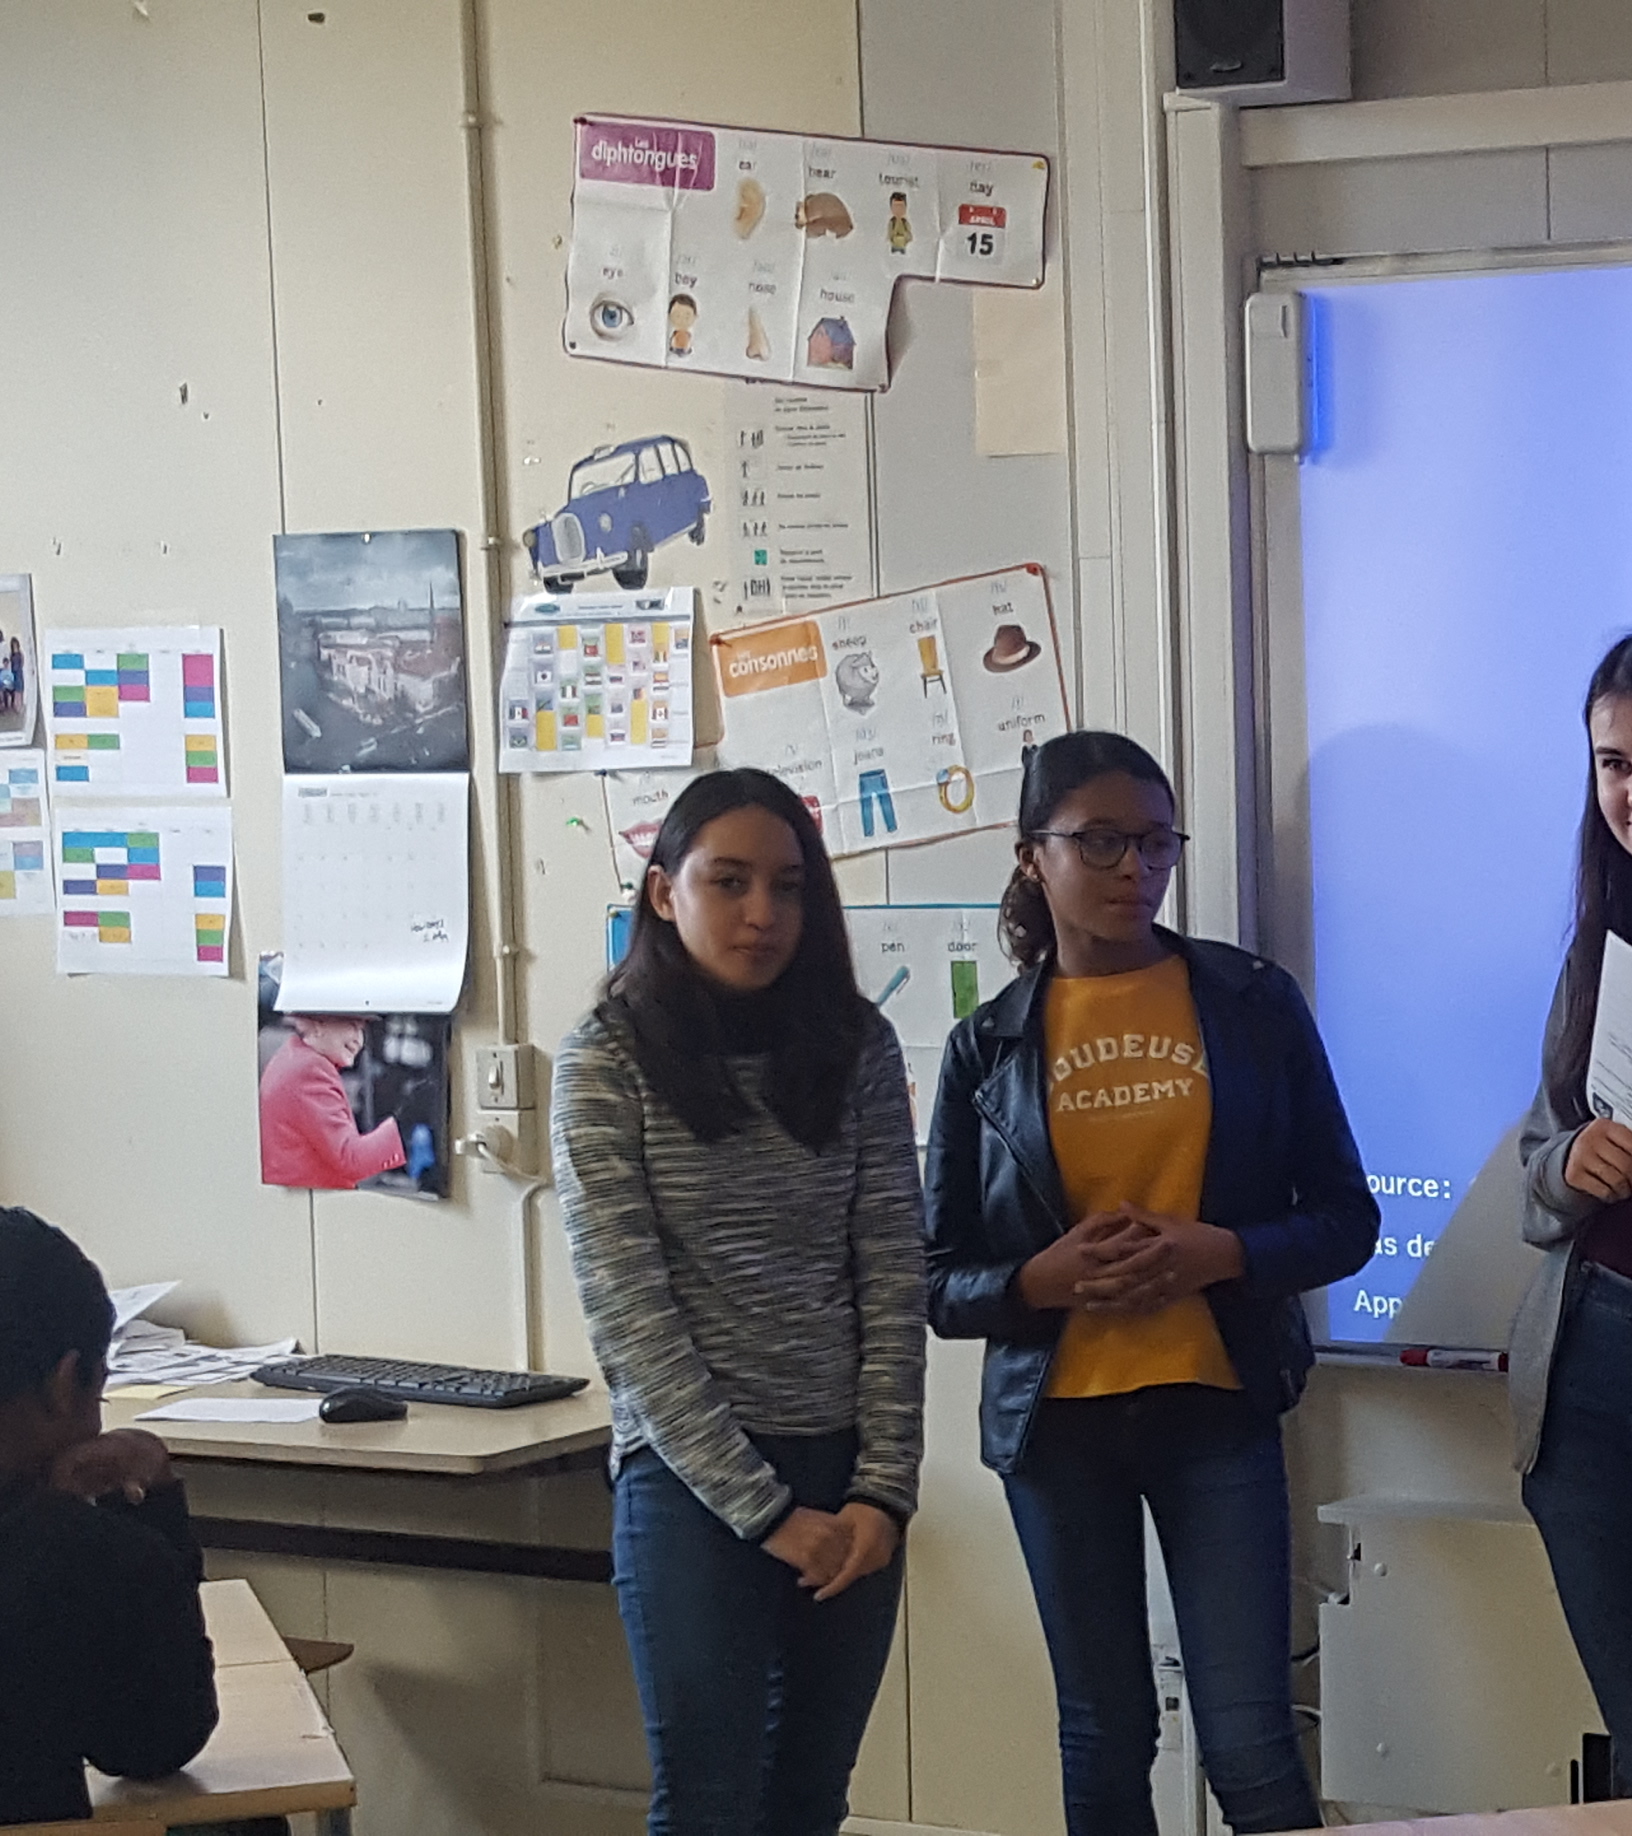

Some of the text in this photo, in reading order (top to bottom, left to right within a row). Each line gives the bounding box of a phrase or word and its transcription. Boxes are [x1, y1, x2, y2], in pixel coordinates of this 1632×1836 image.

[591, 139, 699, 172] diphtongues
[967, 232, 994, 256] 15
[729, 645, 819, 679] consonnes
[998, 713, 1047, 732] uniform
[881, 942, 906, 954] pen
[947, 942, 978, 954] door
[1049, 1033, 1209, 1092] OUDEUS
[1055, 1077, 1195, 1113] ACADEMY
[1366, 1174, 1451, 1199] ource:
